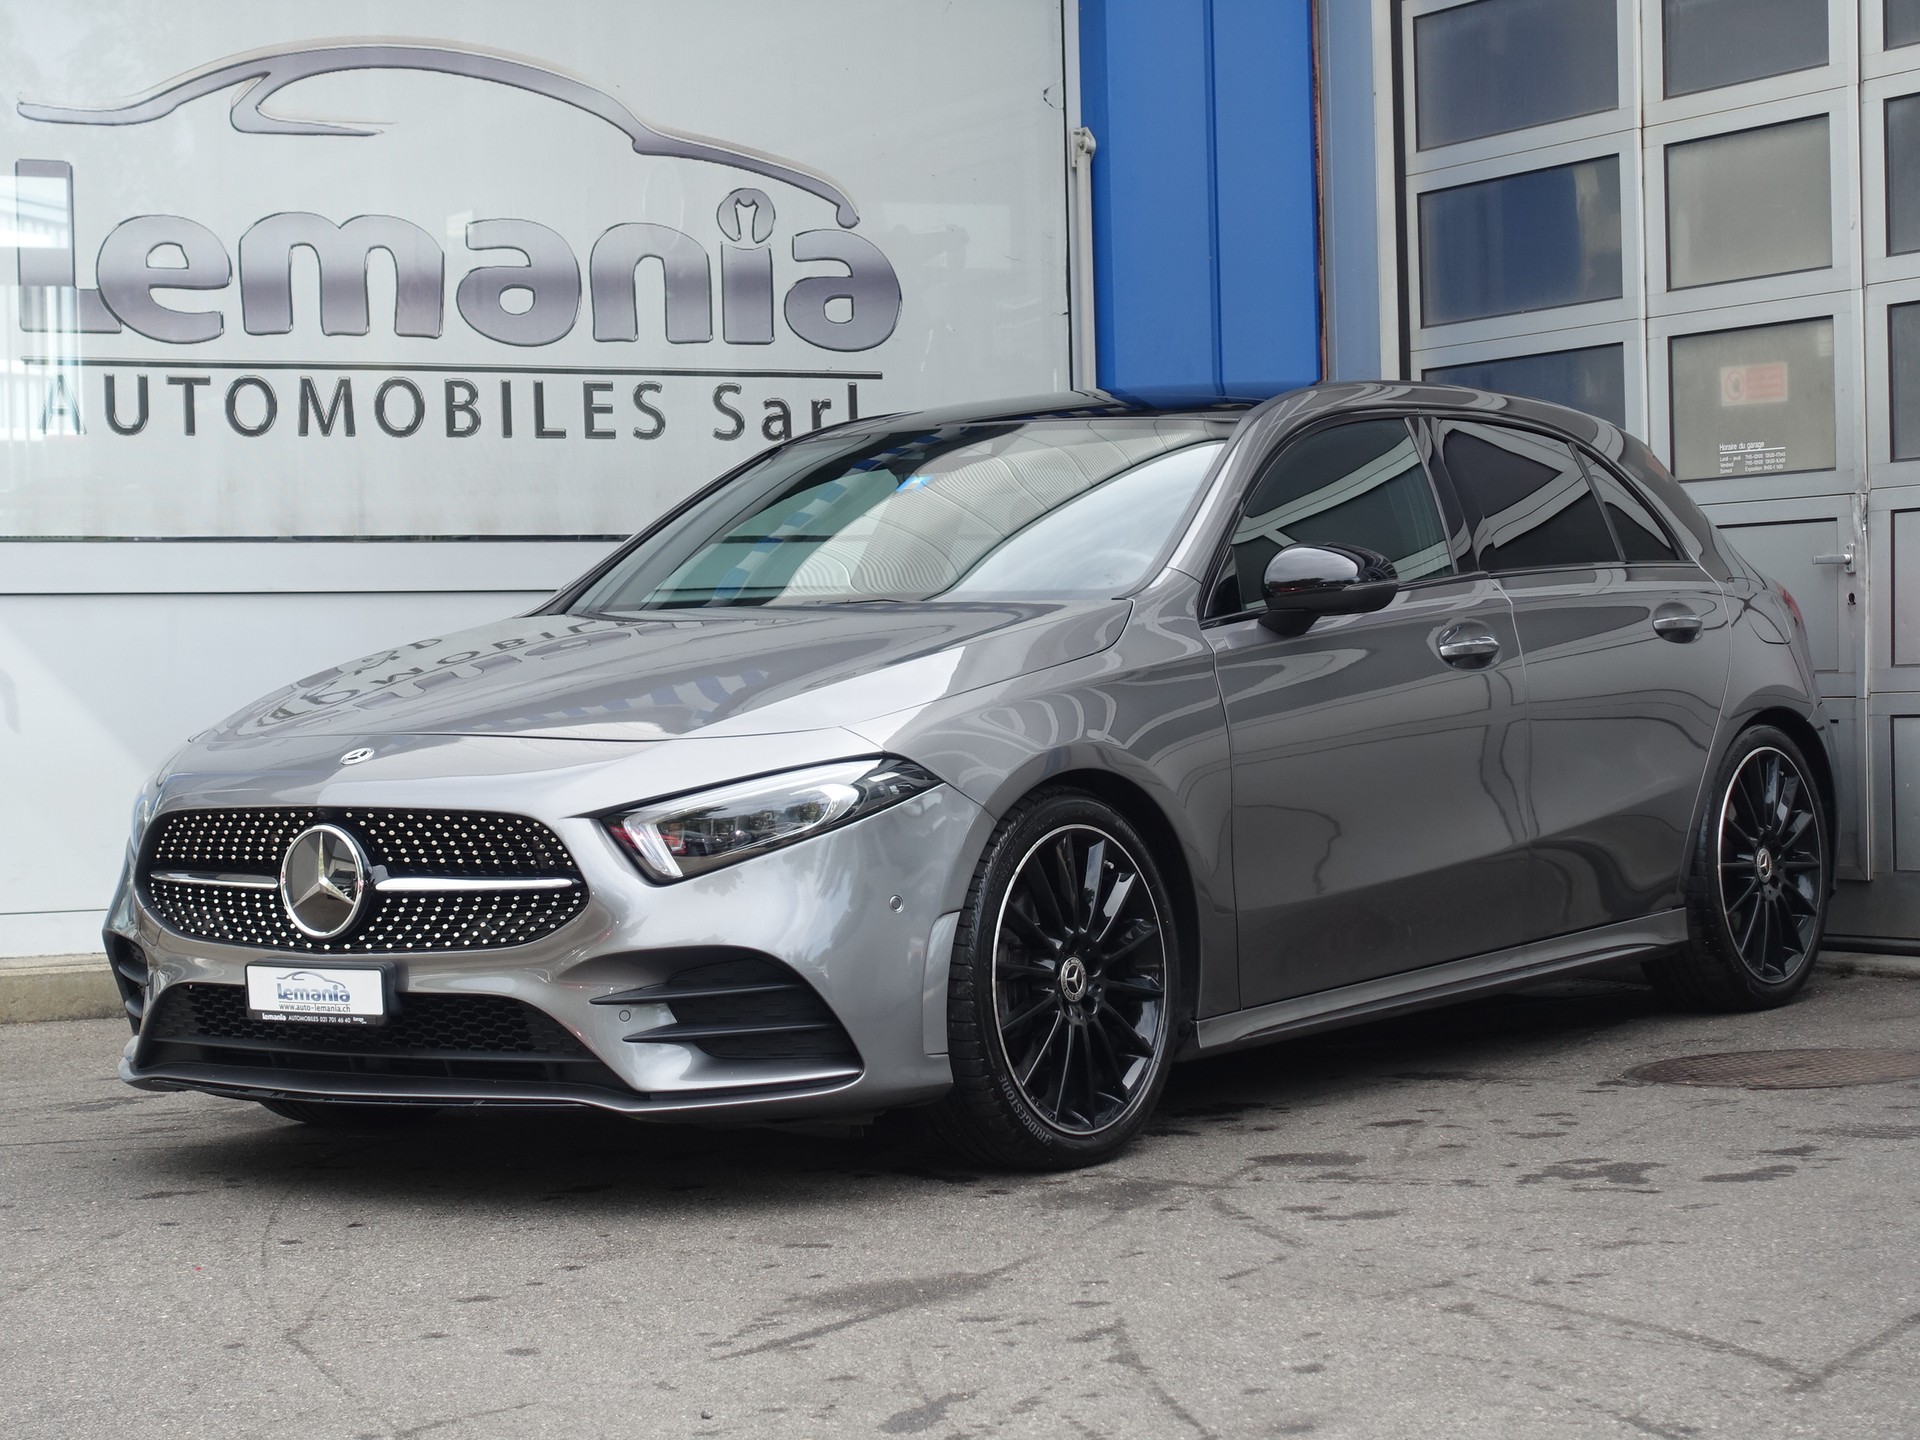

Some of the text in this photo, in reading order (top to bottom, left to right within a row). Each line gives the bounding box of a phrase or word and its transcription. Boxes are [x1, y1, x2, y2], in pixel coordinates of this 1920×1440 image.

[39, 373, 859, 441] AUTOMOBILES Sarl
[1719, 442, 1764, 451] Horaire du garage
[278, 1003, 351, 1012] www.auto-lemania.ch
[998, 1073, 1054, 1146] BRIDGESTONE
